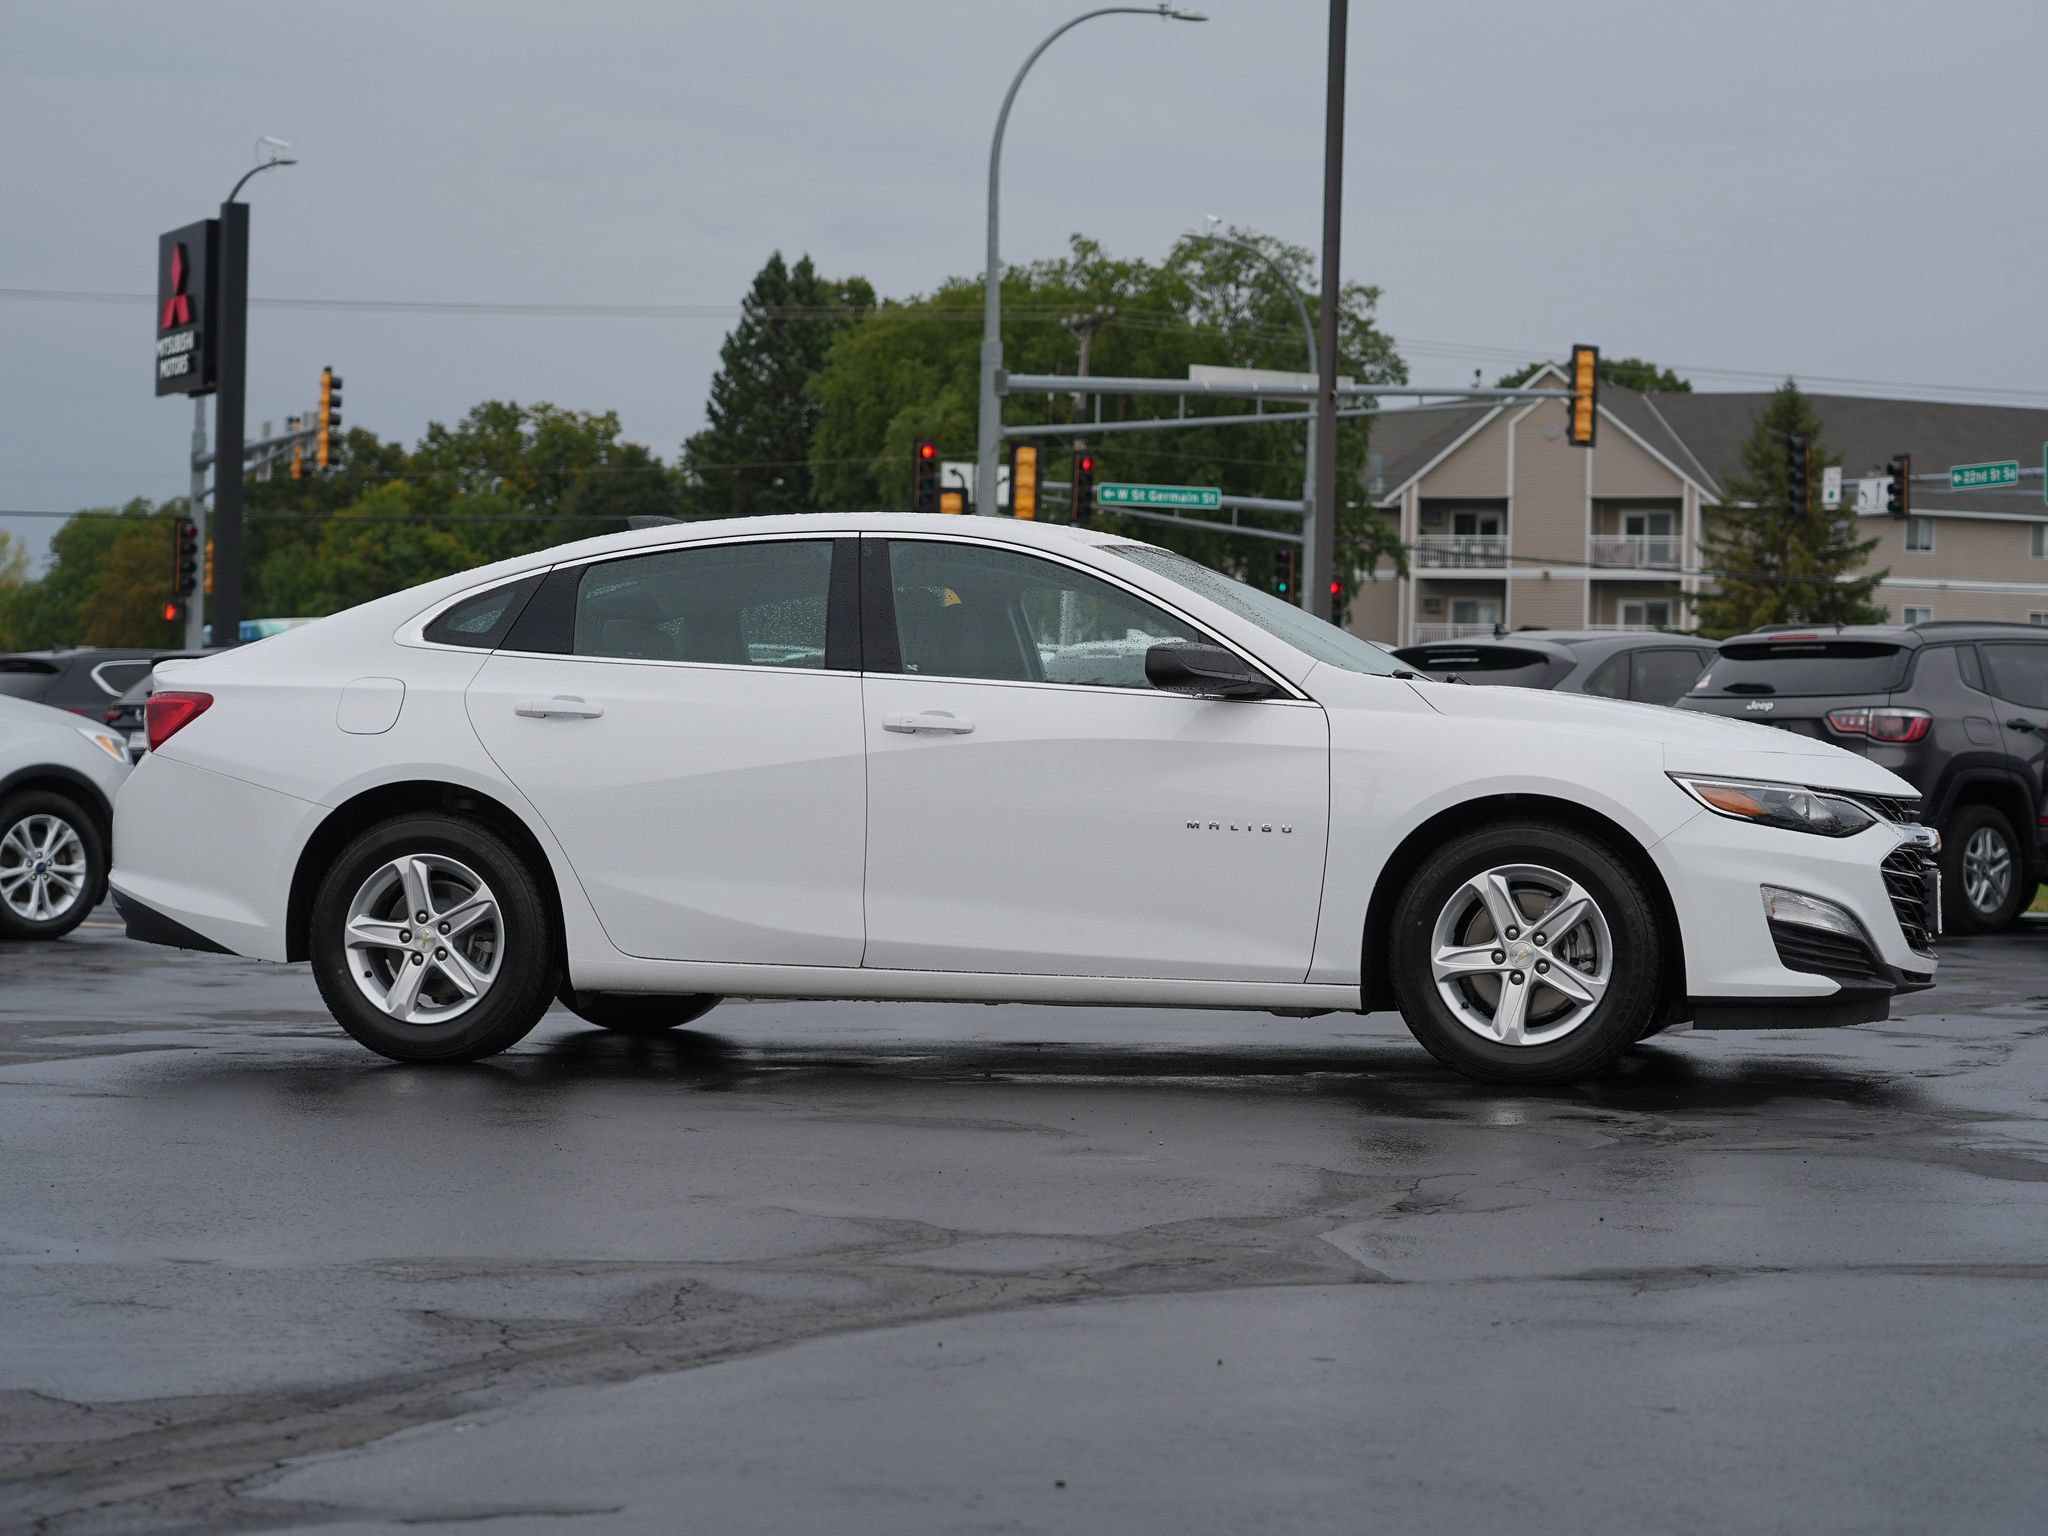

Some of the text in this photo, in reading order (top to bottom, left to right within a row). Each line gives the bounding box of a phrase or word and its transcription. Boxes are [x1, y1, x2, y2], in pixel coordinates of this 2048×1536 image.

[160, 353, 188, 378] MOTORS
[1963, 469, 1987, 485] 22nd
[1990, 467, 2001, 482] St
[1116, 488, 1216, 504] W St Germain St
[1746, 700, 1774, 712] Jeep
[1186, 820, 1292, 834] MALIBU
